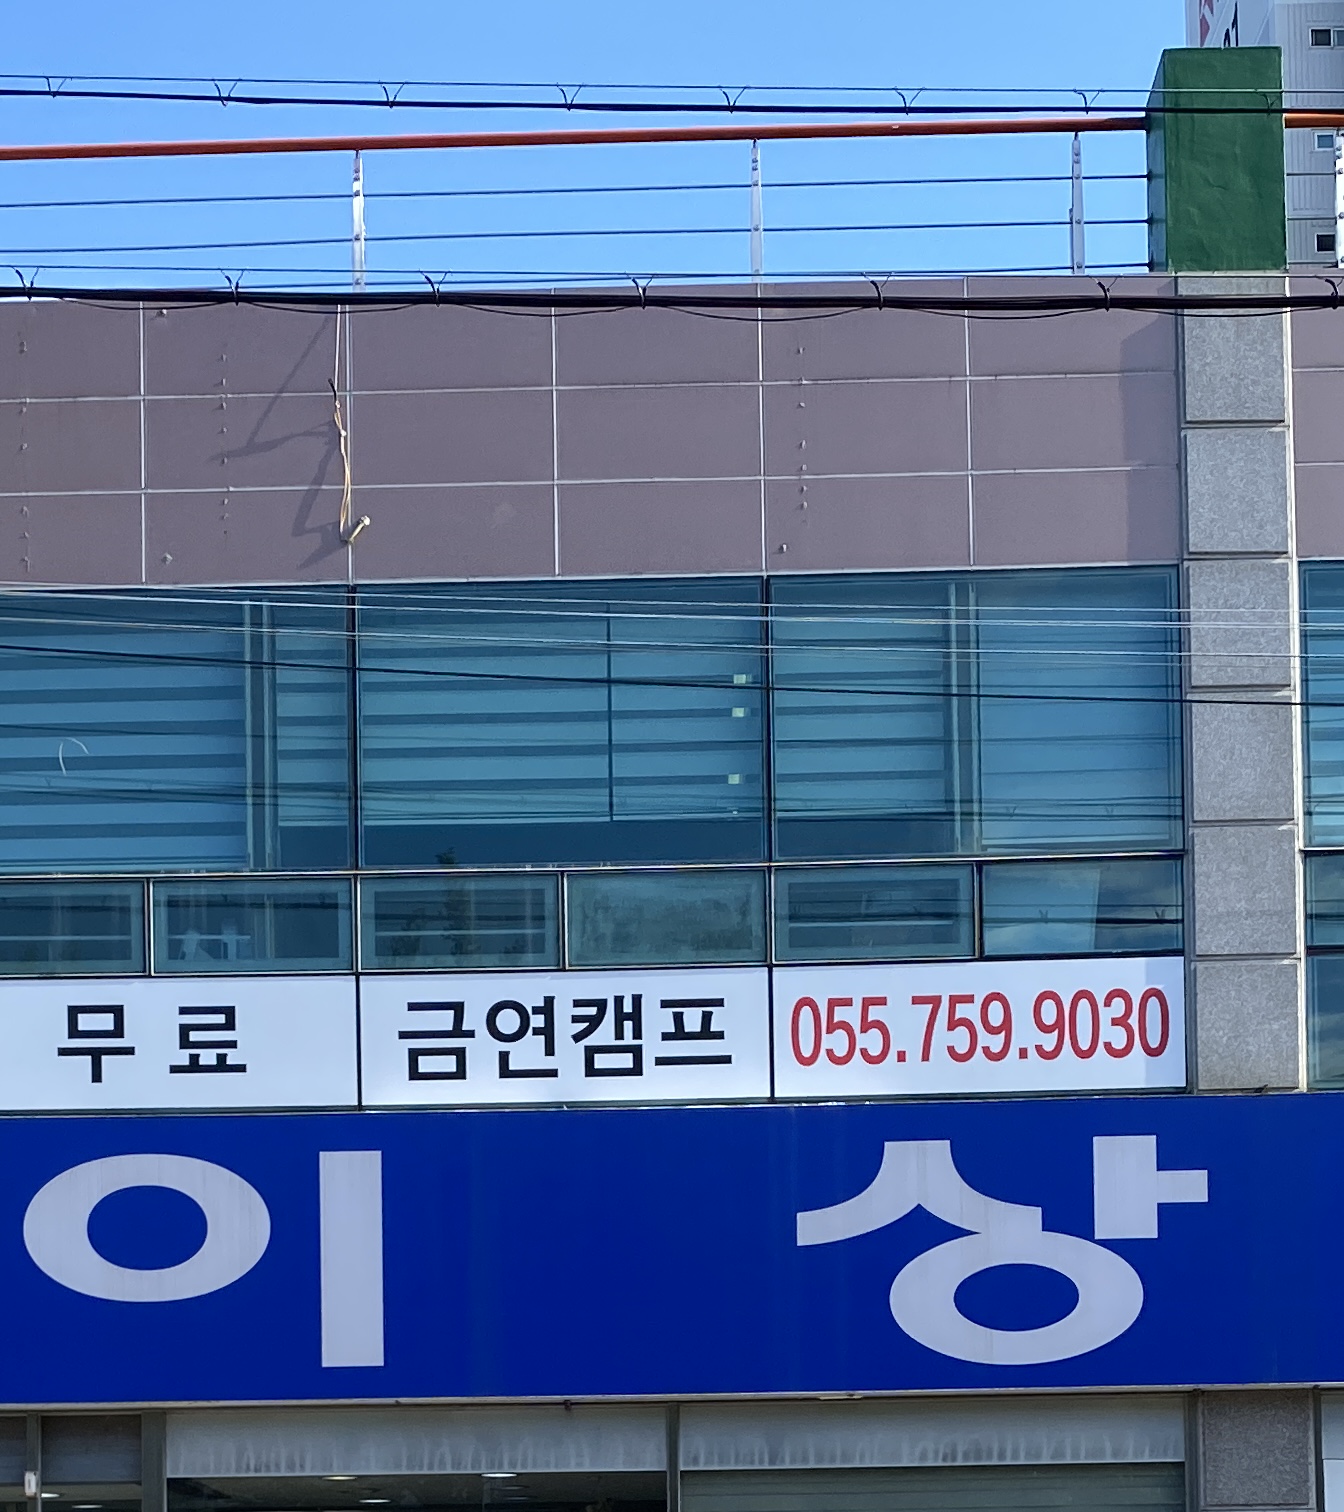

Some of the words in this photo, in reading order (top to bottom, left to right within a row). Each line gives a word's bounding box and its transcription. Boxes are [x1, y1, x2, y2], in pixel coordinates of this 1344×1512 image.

[58, 1005, 248, 1083] 무료
[398, 994, 733, 1081] 금연캠프
[791, 988, 1169, 1067] 055.759.9030
